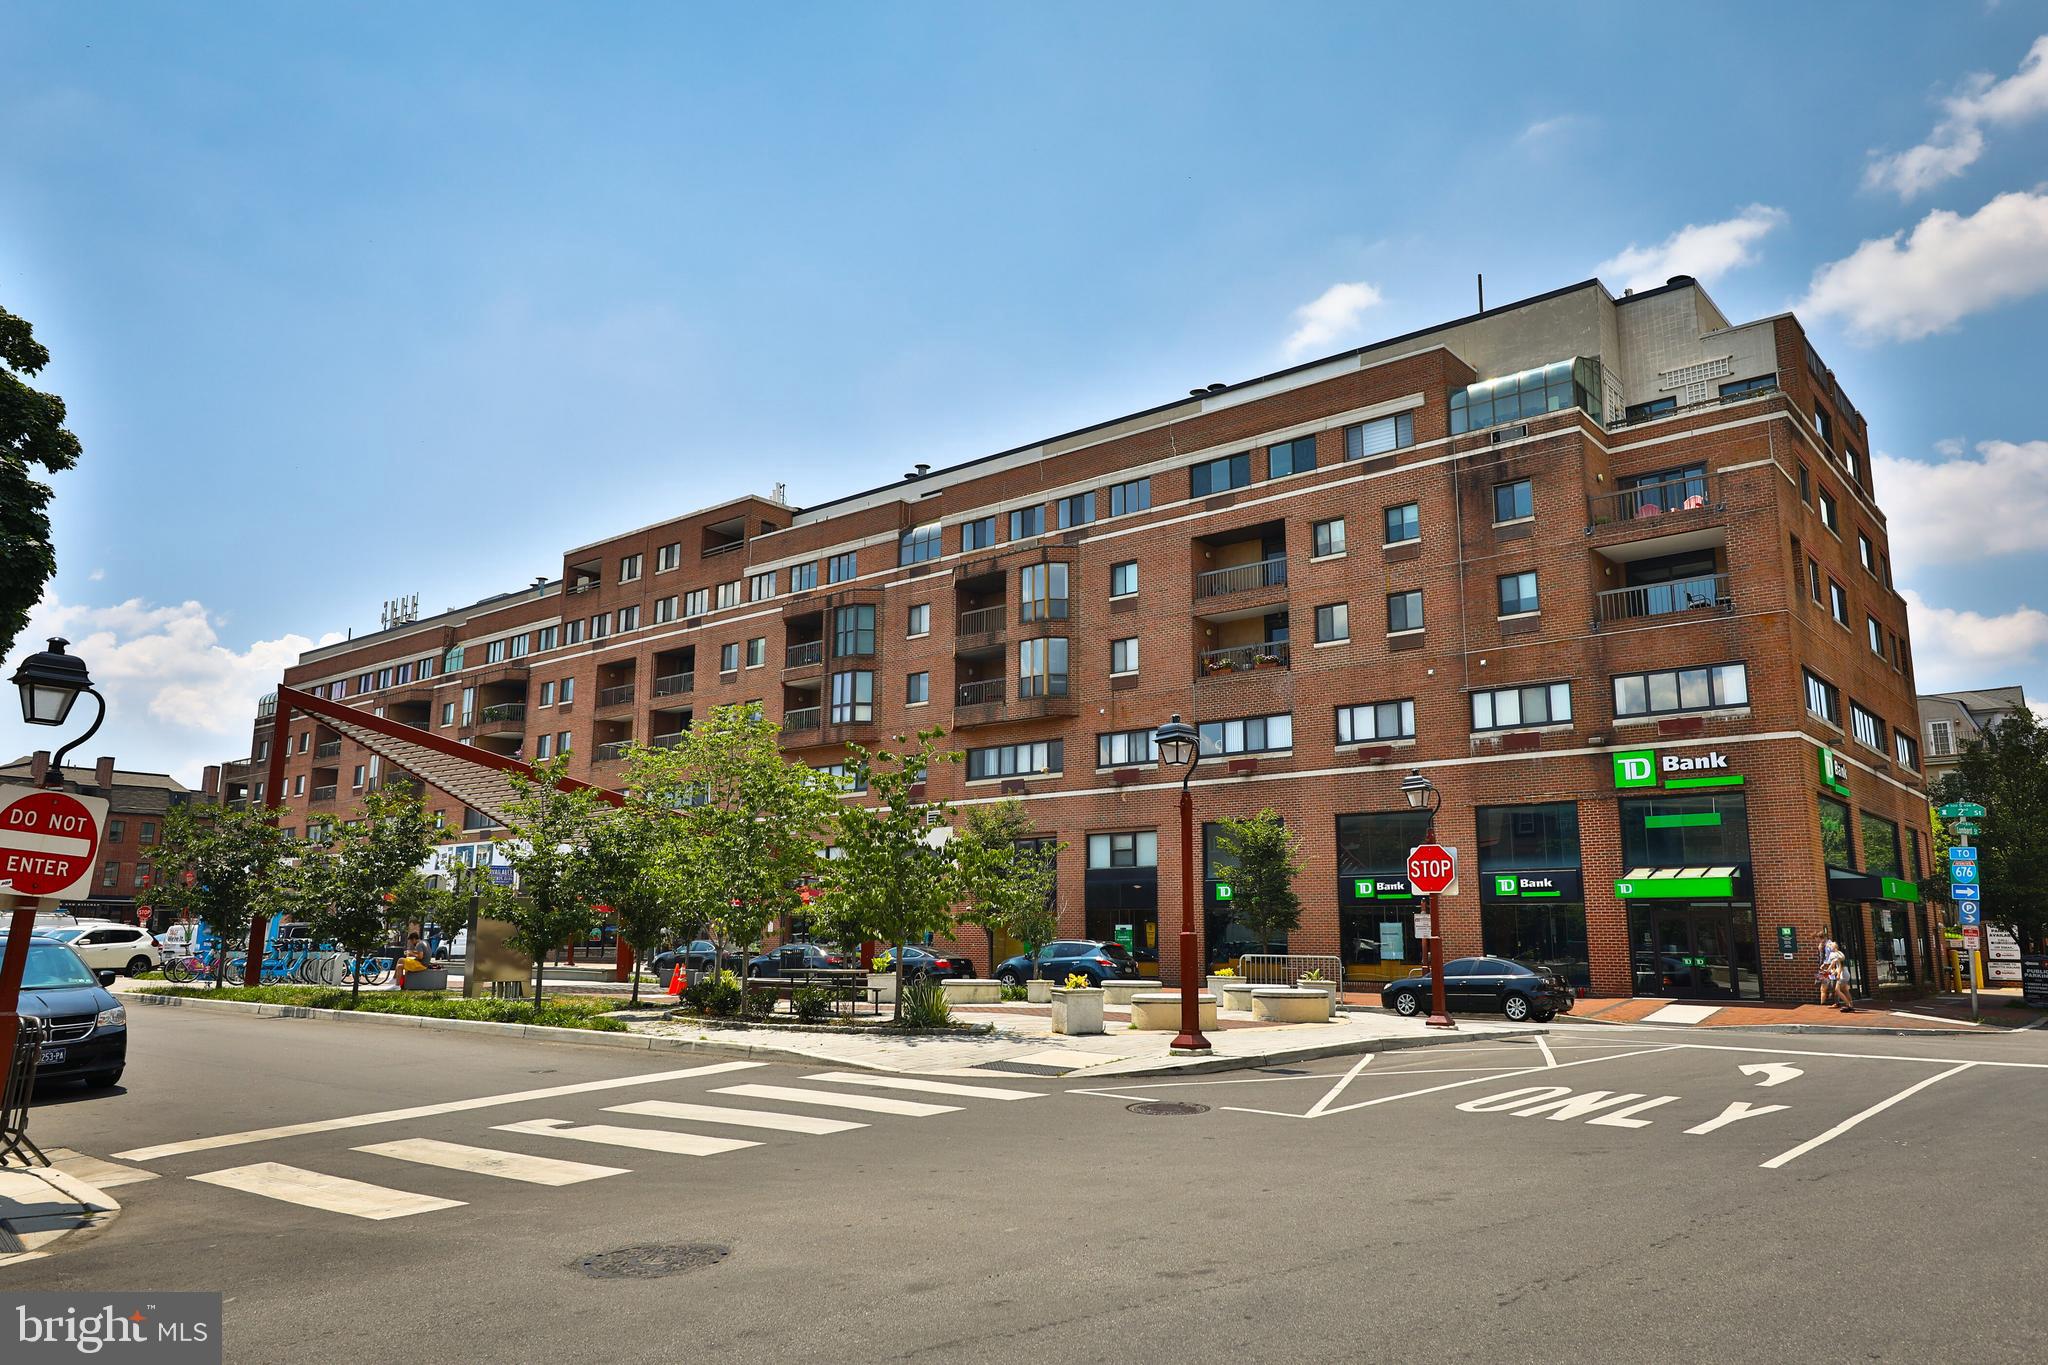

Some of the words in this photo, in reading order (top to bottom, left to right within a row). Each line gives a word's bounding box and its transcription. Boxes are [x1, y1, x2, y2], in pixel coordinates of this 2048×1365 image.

[1617, 758, 1651, 780] TD
[1662, 752, 1728, 772] Bank
[10, 808, 37, 826] DO
[48, 813, 87, 833] NOT
[1957, 850, 1970, 858] TO
[7, 855, 69, 877] ENTER
[1411, 860, 1451, 878] STOP
[1955, 866, 1973, 877] 676
[1217, 886, 1231, 897] TD
[1357, 882, 1373, 894] TD
[1376, 881, 1405, 891] Bank
[1498, 879, 1515, 892] TD
[1520, 877, 1553, 888] Bank
[1617, 883, 1633, 894] TD
[41, 1052, 64, 1062] 253-PA
[1455, 1086, 1792, 1135] ONLY
